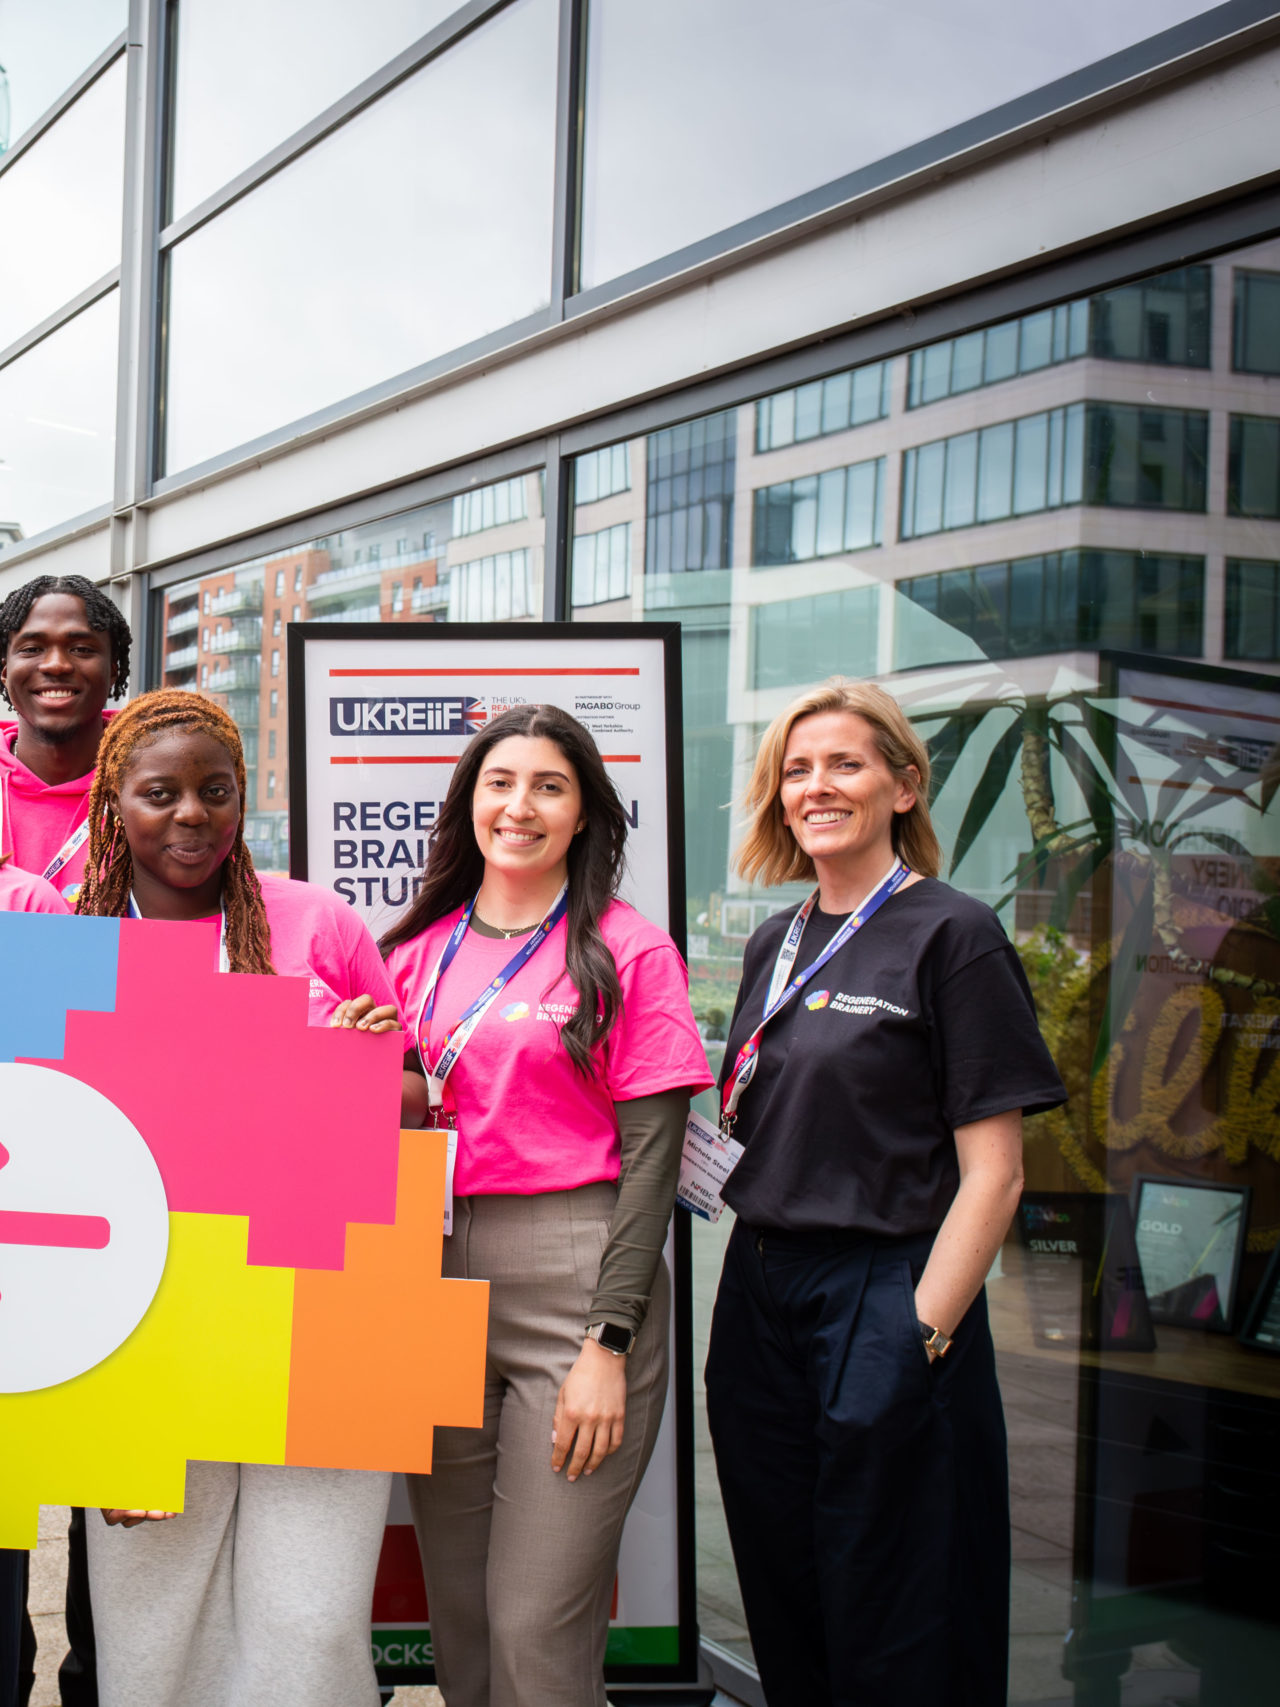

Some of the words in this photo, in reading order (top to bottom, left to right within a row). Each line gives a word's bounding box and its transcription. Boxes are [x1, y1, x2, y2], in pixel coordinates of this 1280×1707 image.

[491, 696, 507, 704] THE
[829, 1001, 877, 1015] BRAINERY
[835, 992, 909, 1016] REGENERATION
[687, 1140, 712, 1162] Michele
[713, 1159, 730, 1175] Steel
[1140, 1219, 1183, 1235] GOLD
[1029, 1239, 1078, 1254] SILVER
